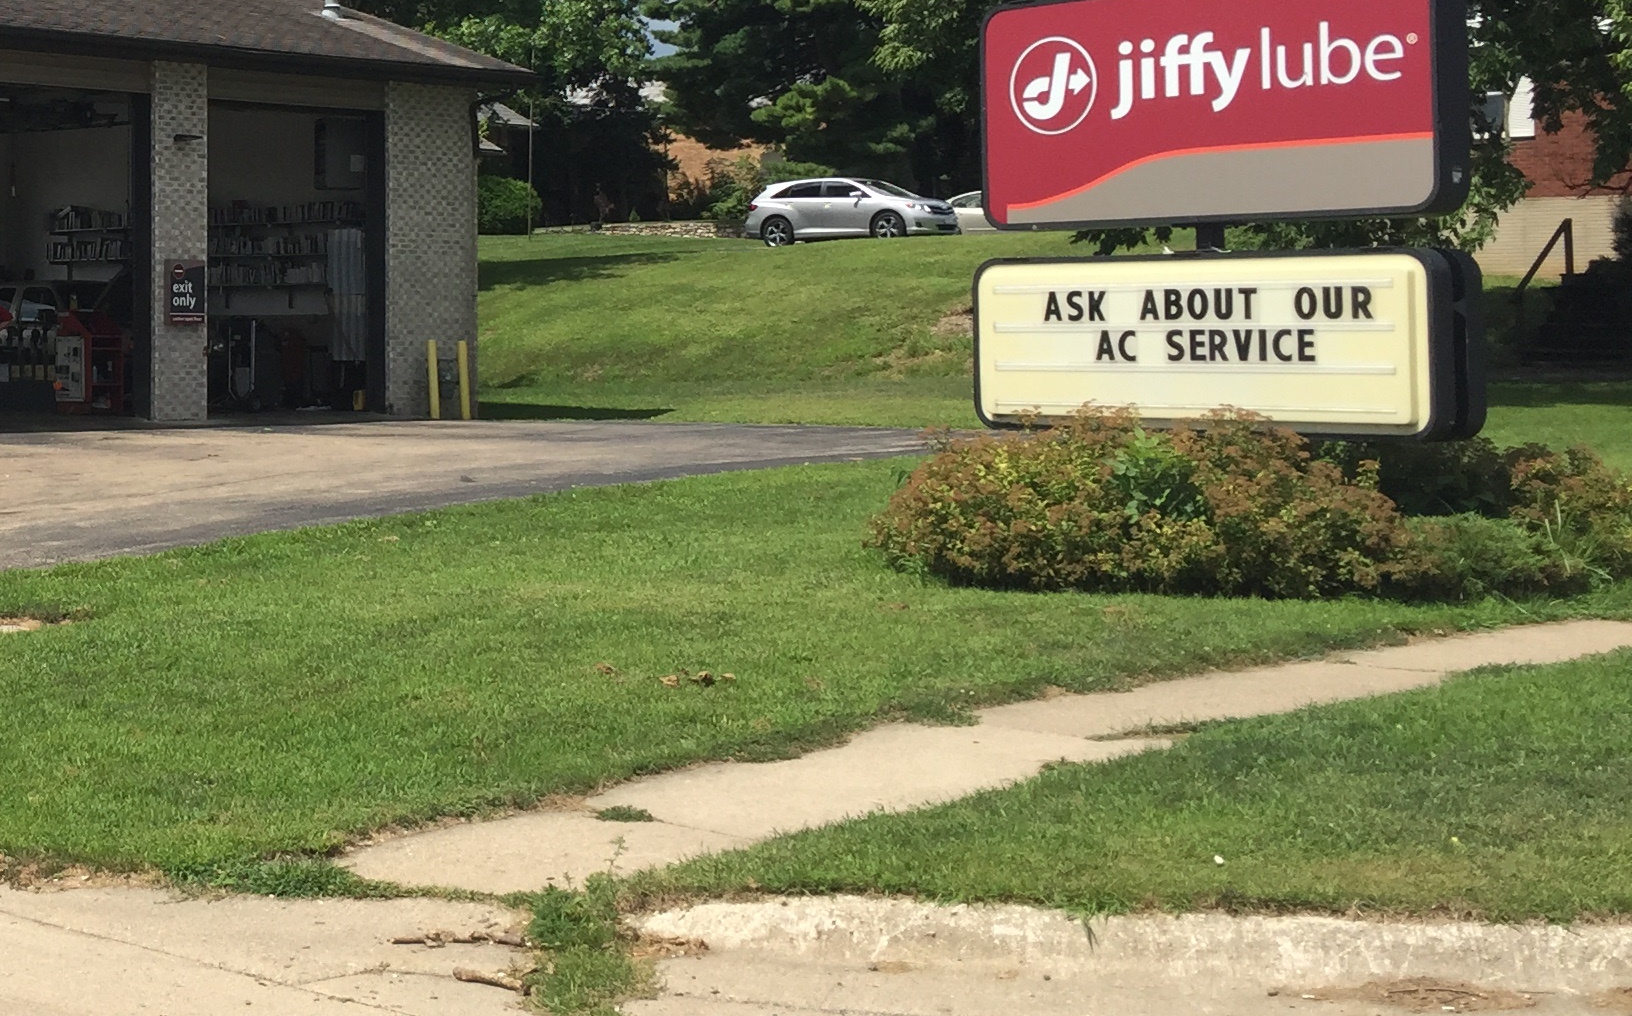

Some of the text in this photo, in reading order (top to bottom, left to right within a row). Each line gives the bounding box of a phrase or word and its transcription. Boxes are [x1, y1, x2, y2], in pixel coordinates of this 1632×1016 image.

[172, 280, 193, 294] exit
[172, 293, 197, 310] only
[1043, 285, 1374, 323] ASK ABOUT OUR
[1095, 327, 1317, 363] AC SERVICE
